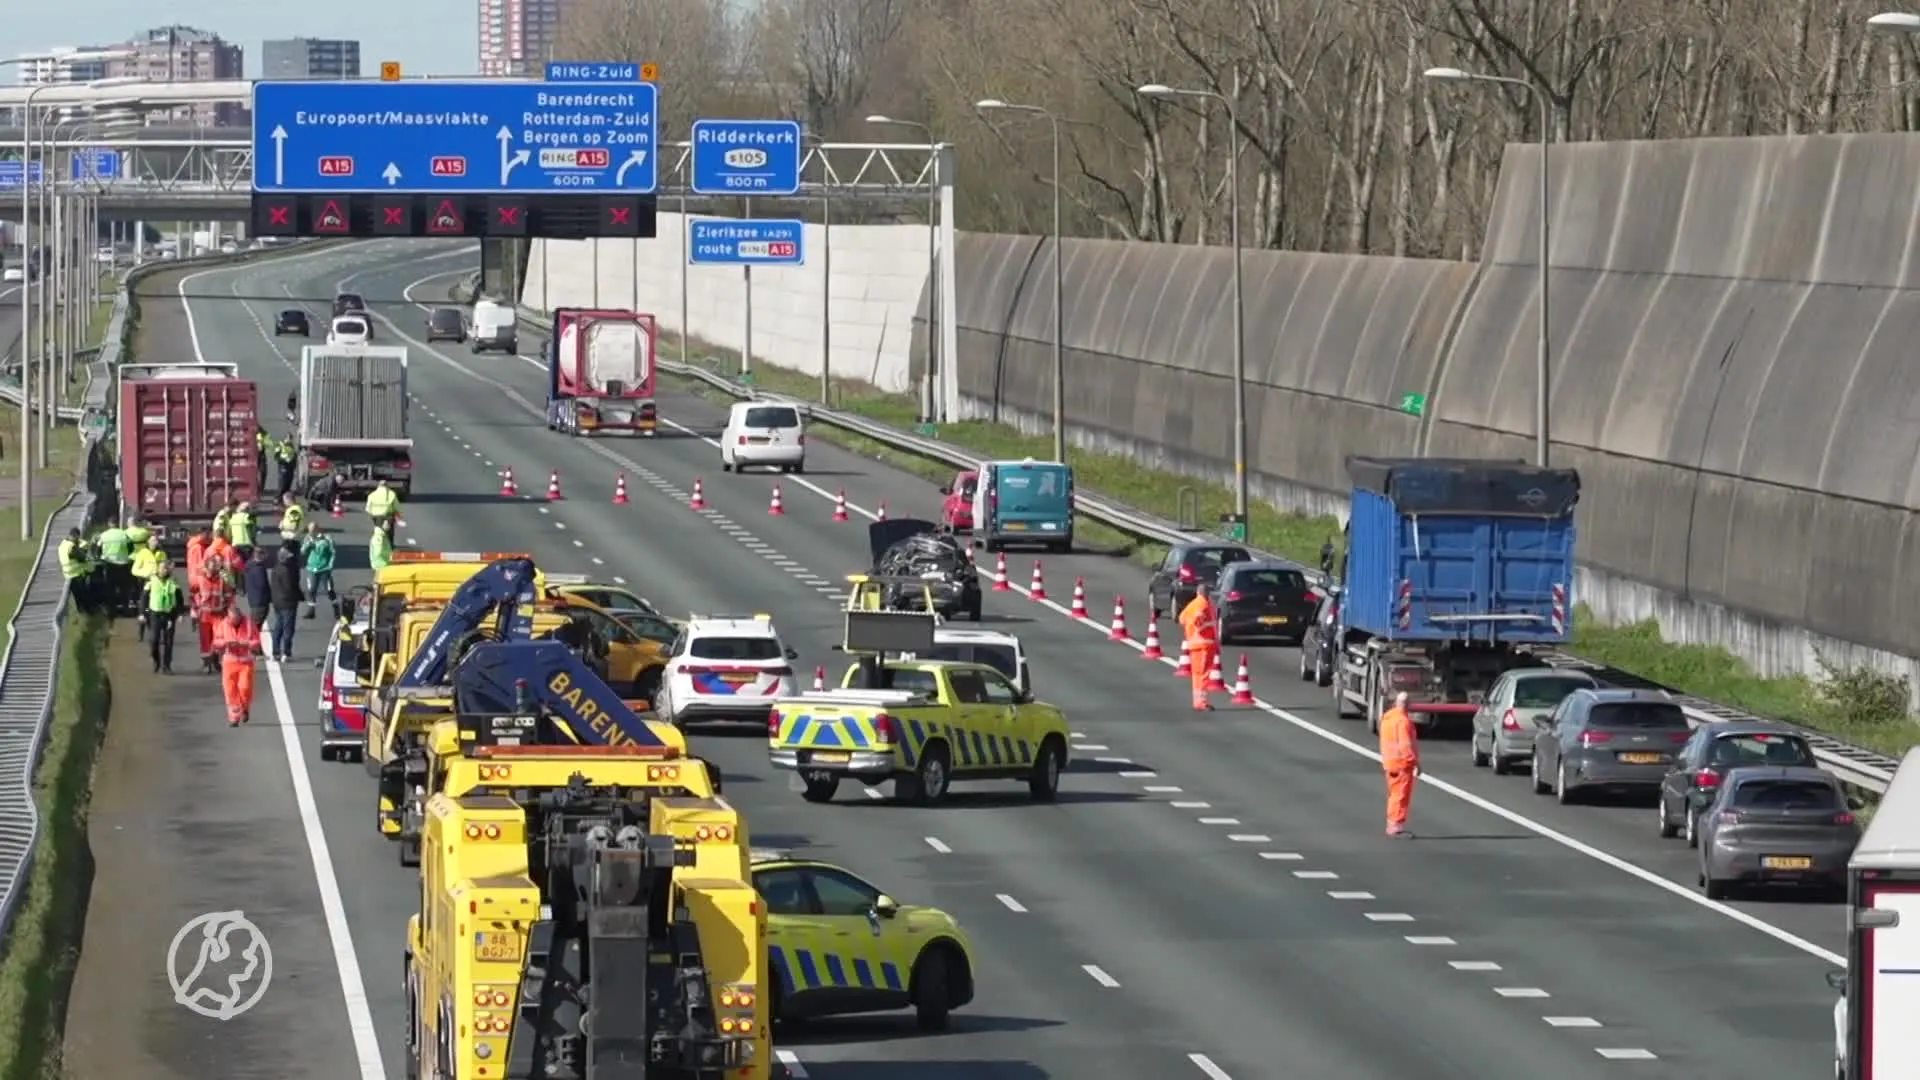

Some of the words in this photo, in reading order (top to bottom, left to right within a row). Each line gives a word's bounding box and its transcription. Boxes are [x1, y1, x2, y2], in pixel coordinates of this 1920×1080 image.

[551, 65, 633, 79] RING-Zuid
[537, 92, 634, 106] Barendrecht
[296, 111, 489, 126] Europoort/Maasvlakte
[522, 112, 650, 126] Rotterdam-Zuid
[523, 130, 578, 147] Bergen
[583, 132, 602, 147] op
[606, 130, 649, 144] Zoom
[698, 129, 795, 144] Ridderkerk
[541, 152, 577, 163] RING
[578, 152, 605, 164] A15
[728, 152, 763, 164] s105
[322, 158, 351, 173] A15
[434, 158, 462, 173] A15
[553, 175, 581, 187] 600
[582, 176, 595, 186] m
[725, 176, 752, 187] 800
[754, 177, 767, 187] m
[696, 225, 759, 239] Zierikzee
[698, 242, 733, 254] route
[739, 244, 768, 255] RING
[770, 243, 793, 255] A15
